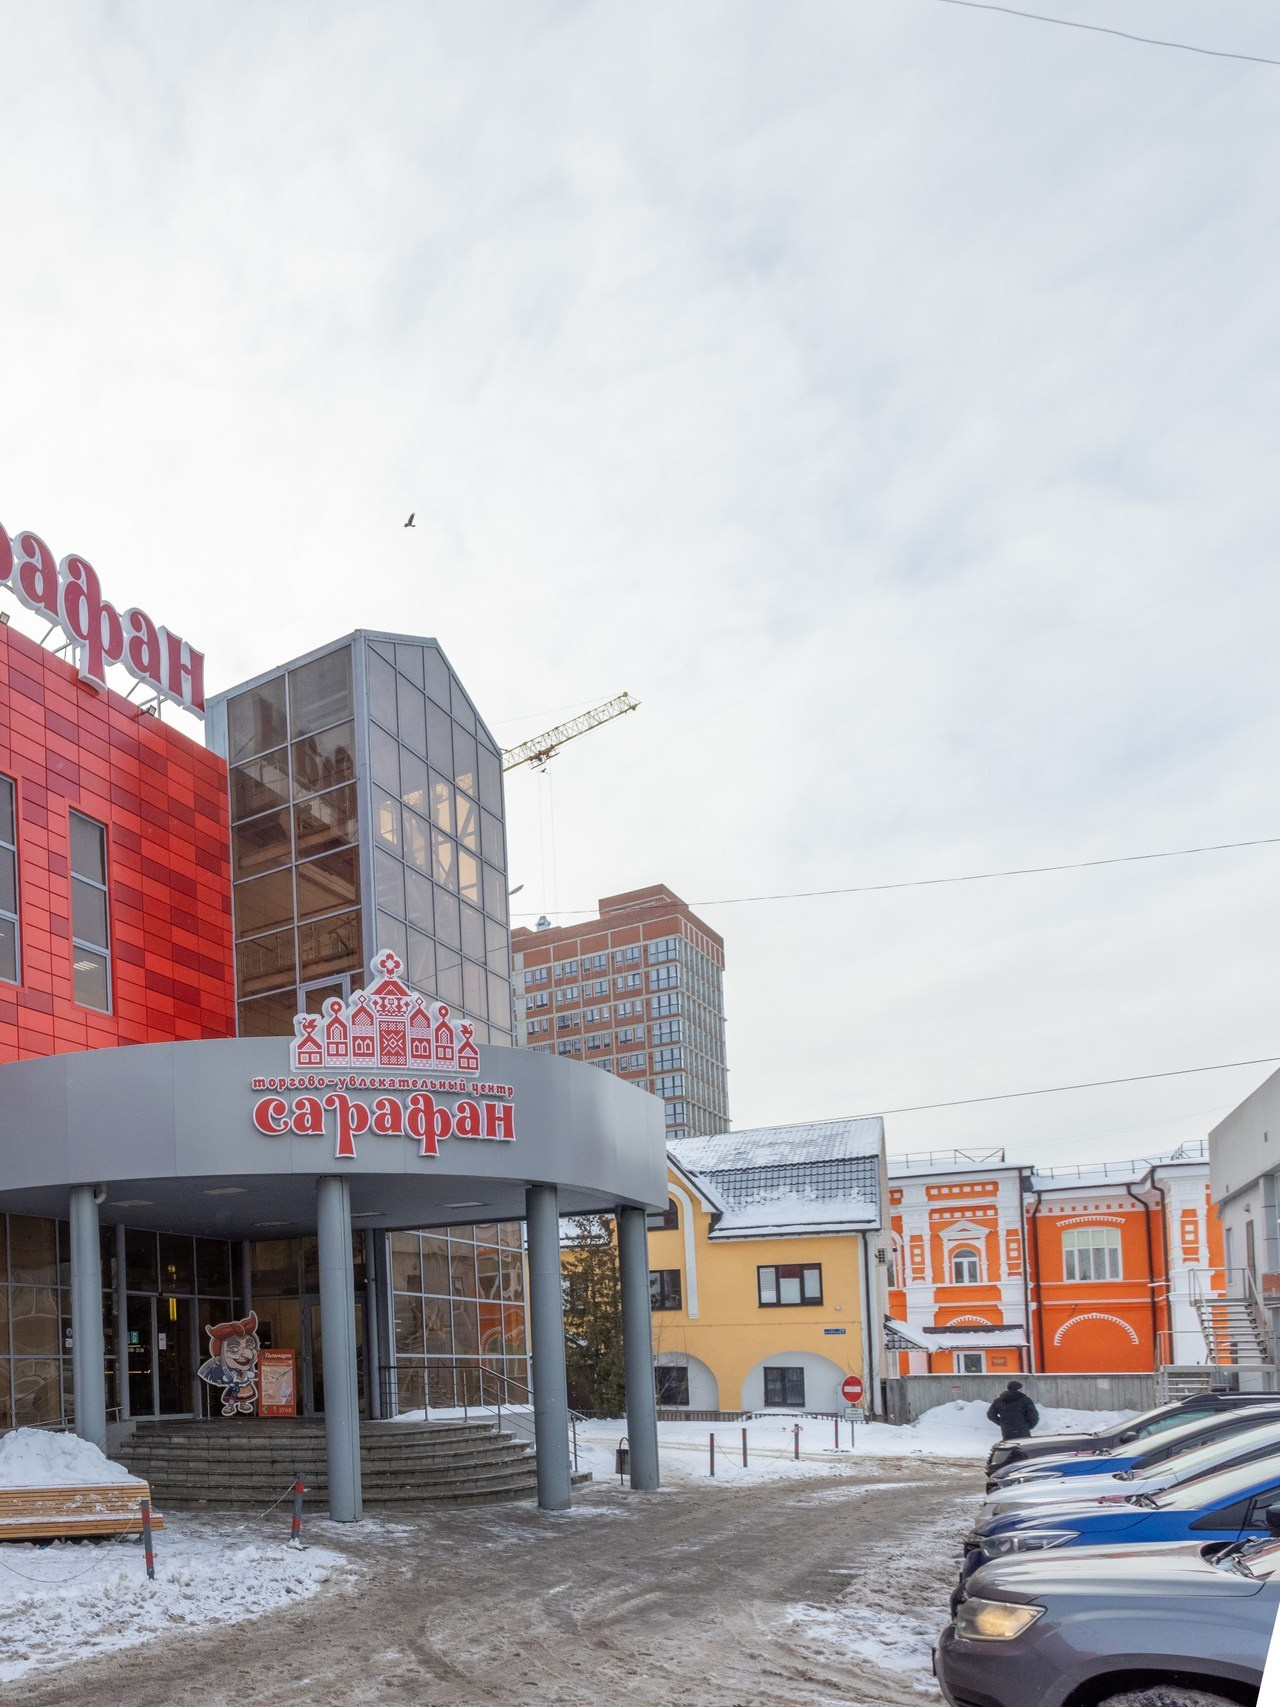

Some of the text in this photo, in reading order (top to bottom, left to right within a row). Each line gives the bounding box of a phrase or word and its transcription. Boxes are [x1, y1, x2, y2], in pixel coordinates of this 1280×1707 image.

[252, 1075, 514, 1098] торгово-увлекательный центр
[253, 1092, 516, 1158] сарафан
